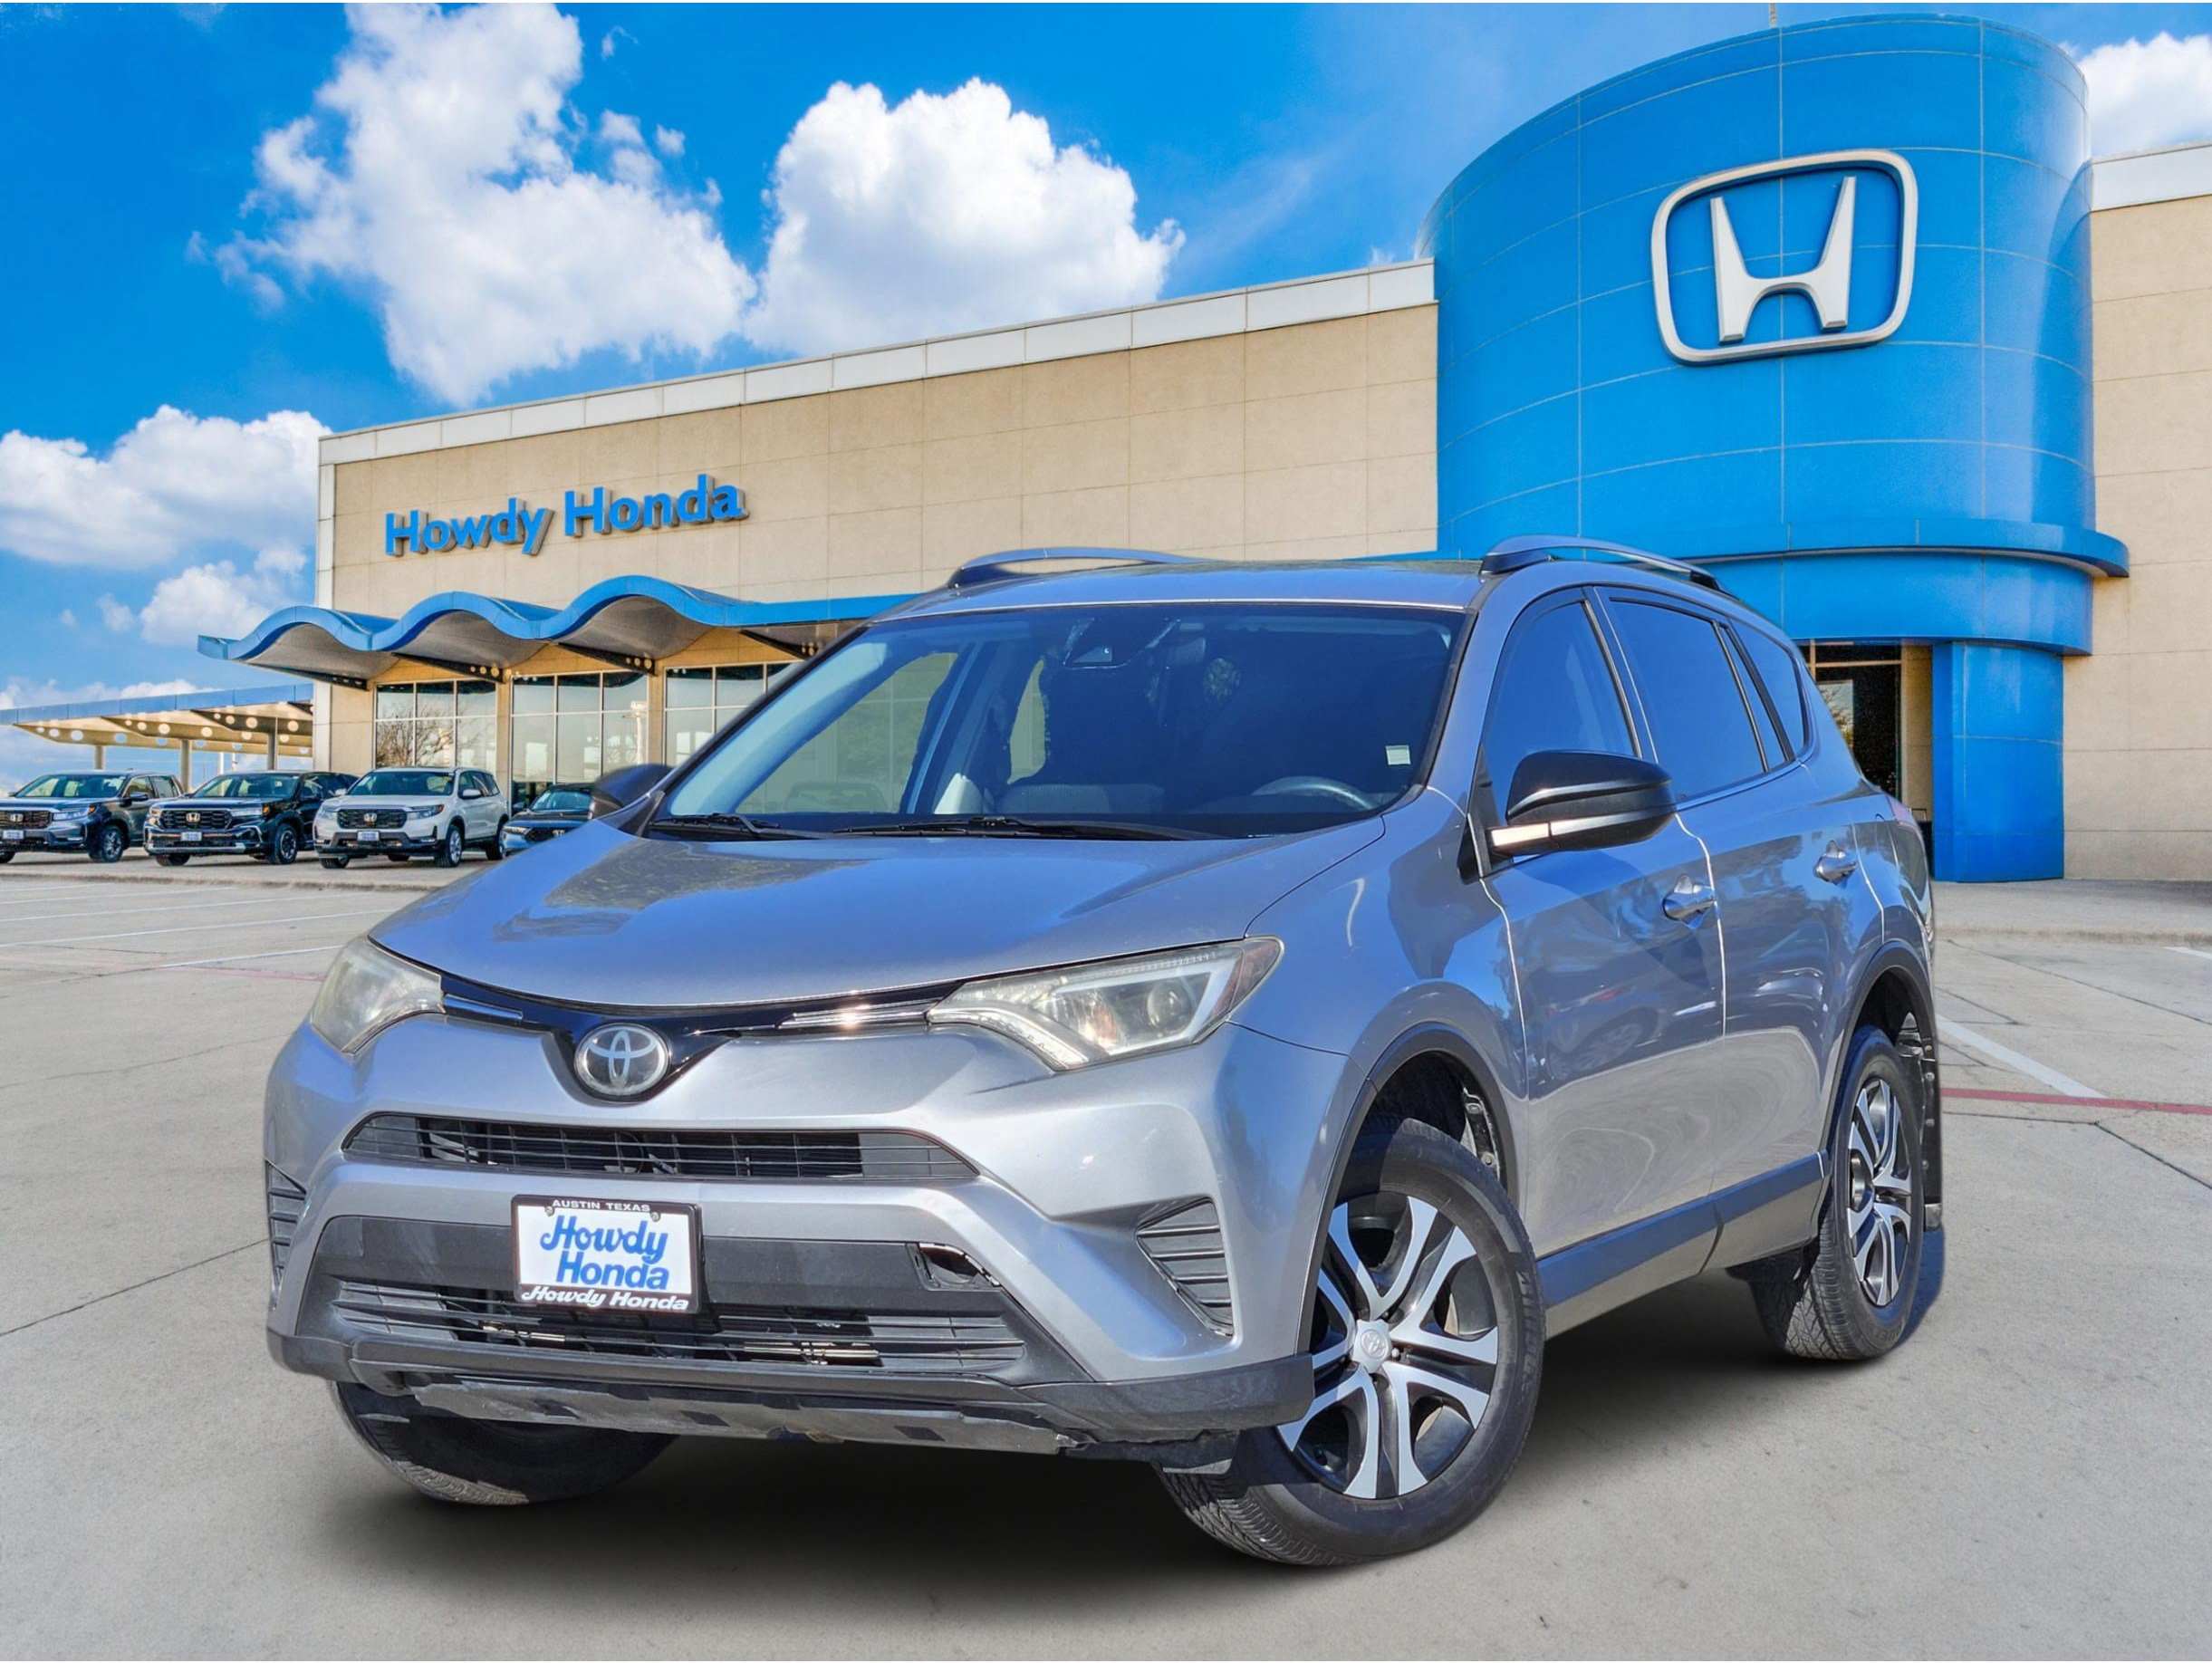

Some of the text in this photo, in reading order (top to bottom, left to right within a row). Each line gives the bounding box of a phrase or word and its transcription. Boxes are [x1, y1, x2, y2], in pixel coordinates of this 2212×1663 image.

[384, 473, 749, 557] Howdy Honda
[552, 1199, 650, 1212] AUSTIN TEXAS
[540, 1215, 668, 1264] Howdy
[555, 1250, 670, 1290] Honda
[522, 1285, 689, 1311] Howdy Honda
